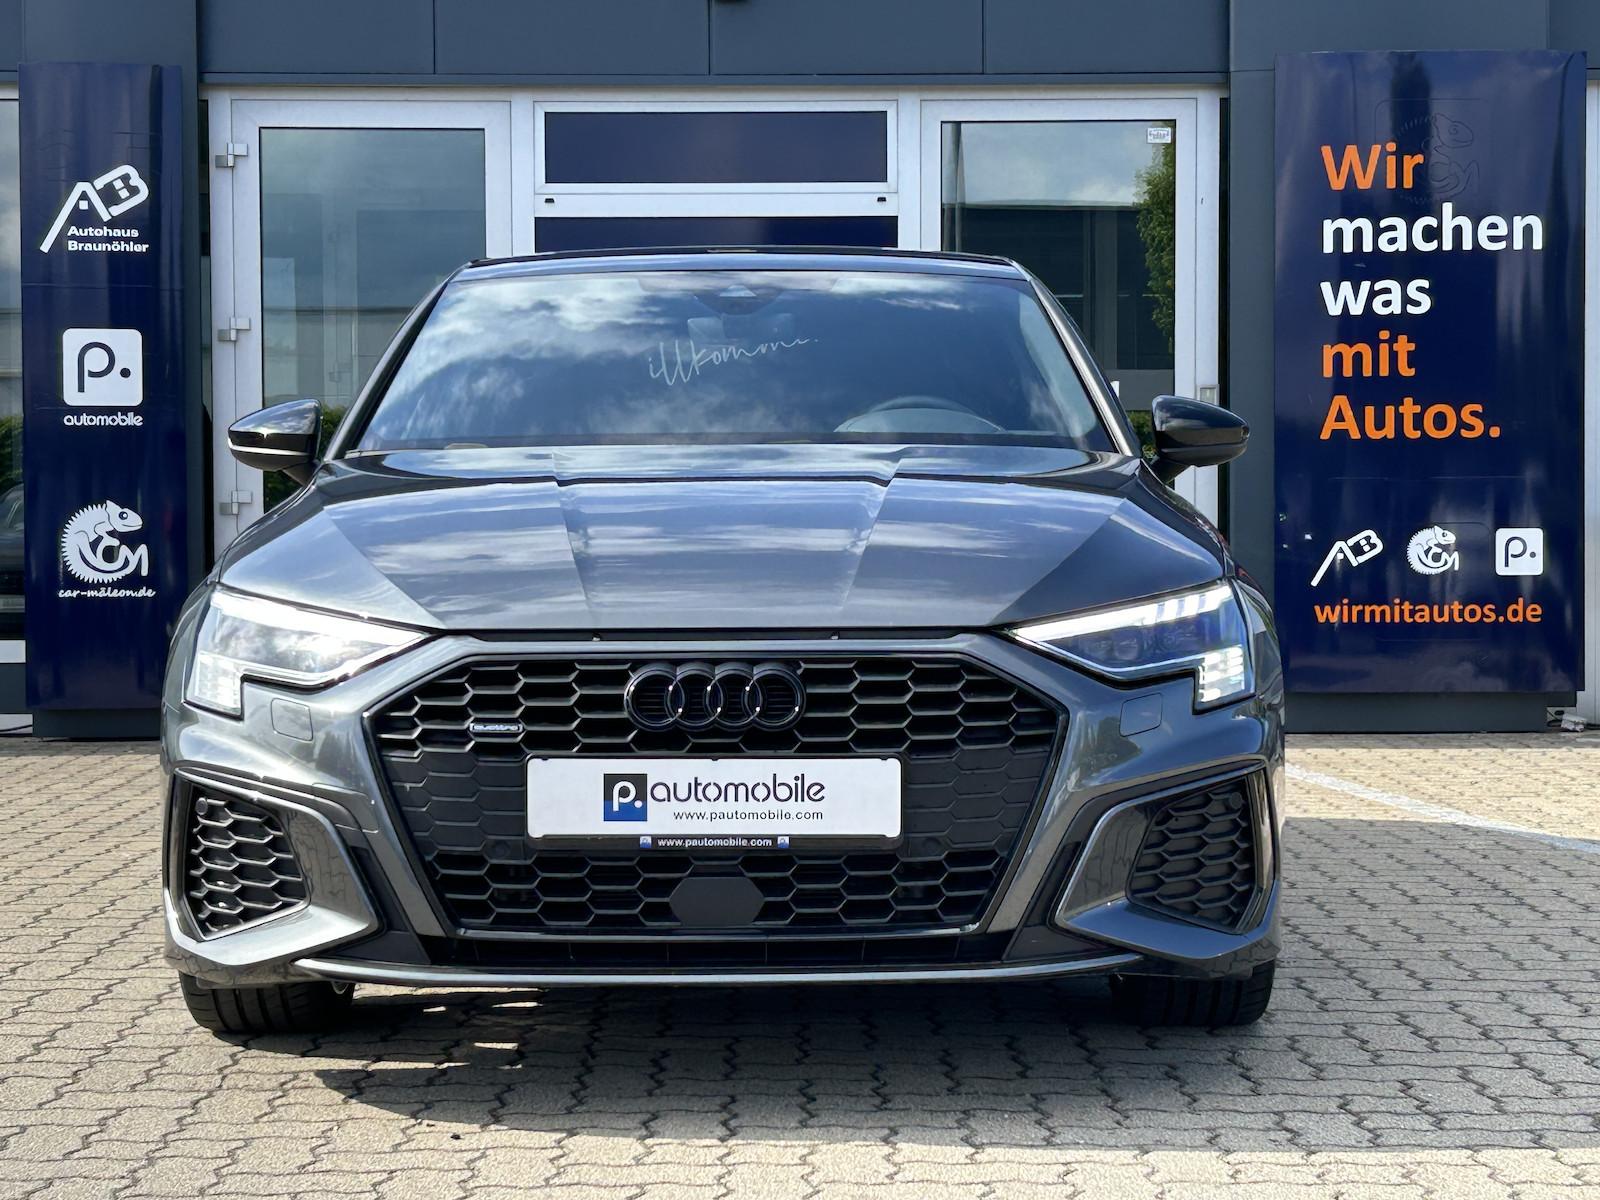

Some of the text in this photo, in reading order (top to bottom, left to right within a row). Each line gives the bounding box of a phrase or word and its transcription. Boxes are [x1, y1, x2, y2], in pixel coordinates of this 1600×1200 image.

[1321, 143, 1425, 191] Wir
[66, 226, 140, 239] Autohaus
[1322, 201, 1544, 254] machen
[67, 240, 150, 253] Braunöhler
[1320, 278, 1432, 316] was
[1322, 329, 1416, 378] mit
[63, 411, 144, 427] automobile
[1319, 395, 1502, 440] Autos.
[1314, 598, 1543, 623] wirmitautos.de
[650, 773, 826, 803] automobile
[673, 809, 824, 822] www.pautomobile.com
[657, 837, 773, 848] www.pautomobile.com
